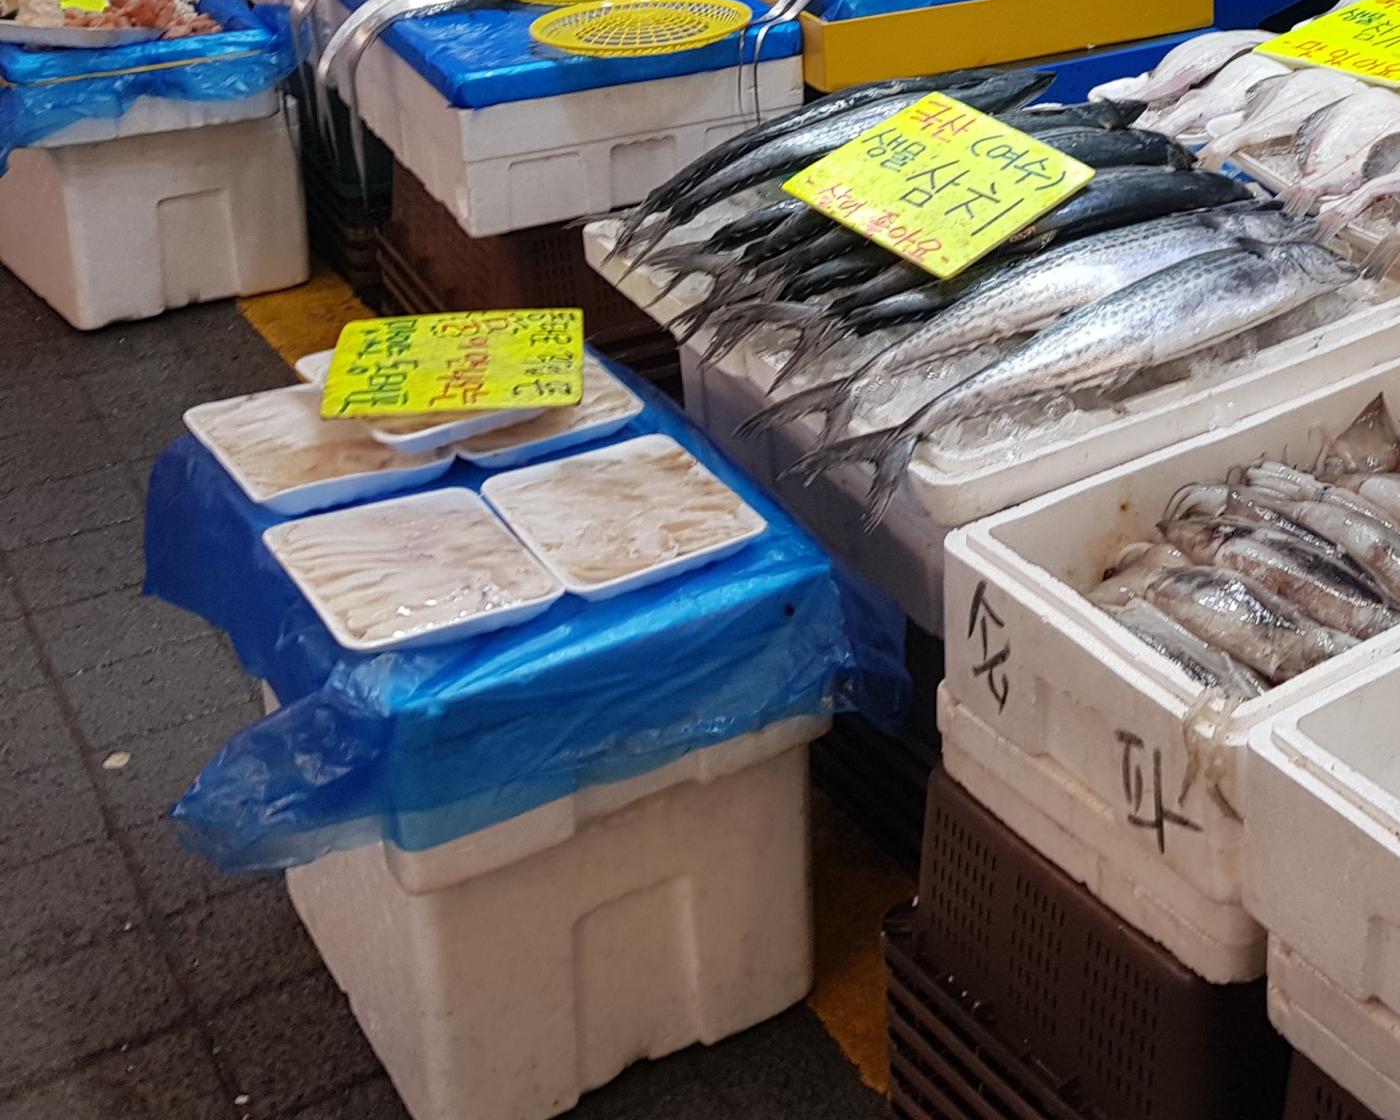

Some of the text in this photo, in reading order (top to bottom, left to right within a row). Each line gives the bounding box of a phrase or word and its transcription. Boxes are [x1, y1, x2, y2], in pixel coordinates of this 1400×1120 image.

[1338, 7, 1384, 26] 생물
[861, 127, 1026, 238] 생물 삼치
[909, 100, 1066, 191] 국산 (여수)
